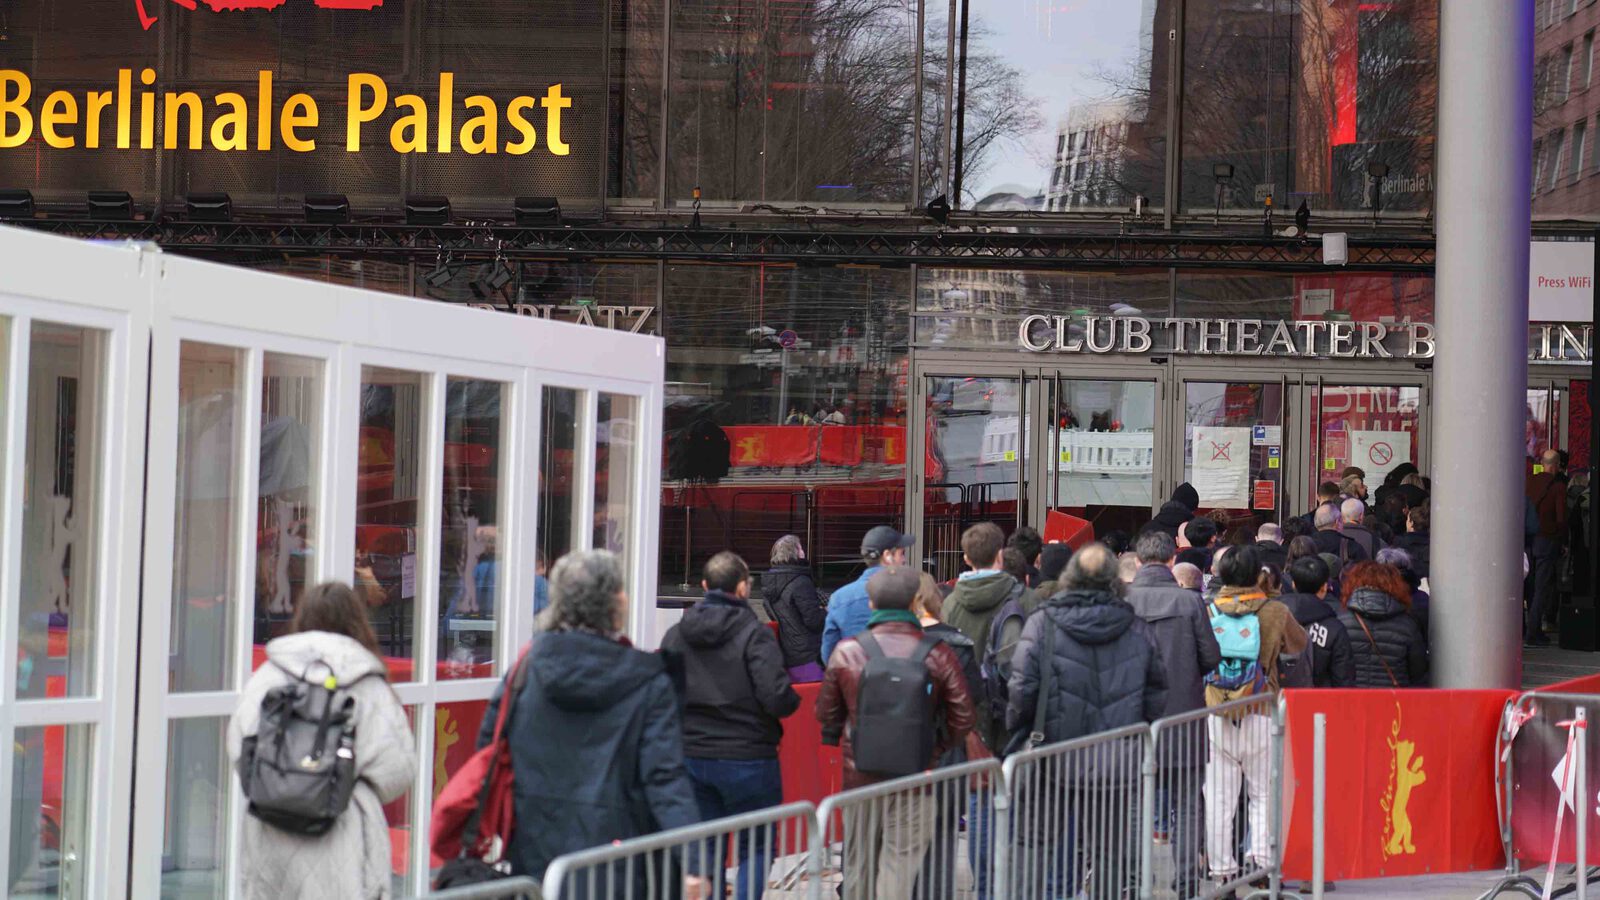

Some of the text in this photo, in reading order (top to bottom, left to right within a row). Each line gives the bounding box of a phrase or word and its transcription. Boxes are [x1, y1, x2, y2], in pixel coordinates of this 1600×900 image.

[0, 68, 572, 156] Berlinale Palast
[1381, 173, 1425, 193] Berlinale
[1537, 275, 1592, 289] Press WiFi
[1019, 314, 1152, 353] CLUB
[1164, 317, 1394, 358] THEATER
[1309, 621, 1328, 648] 69
